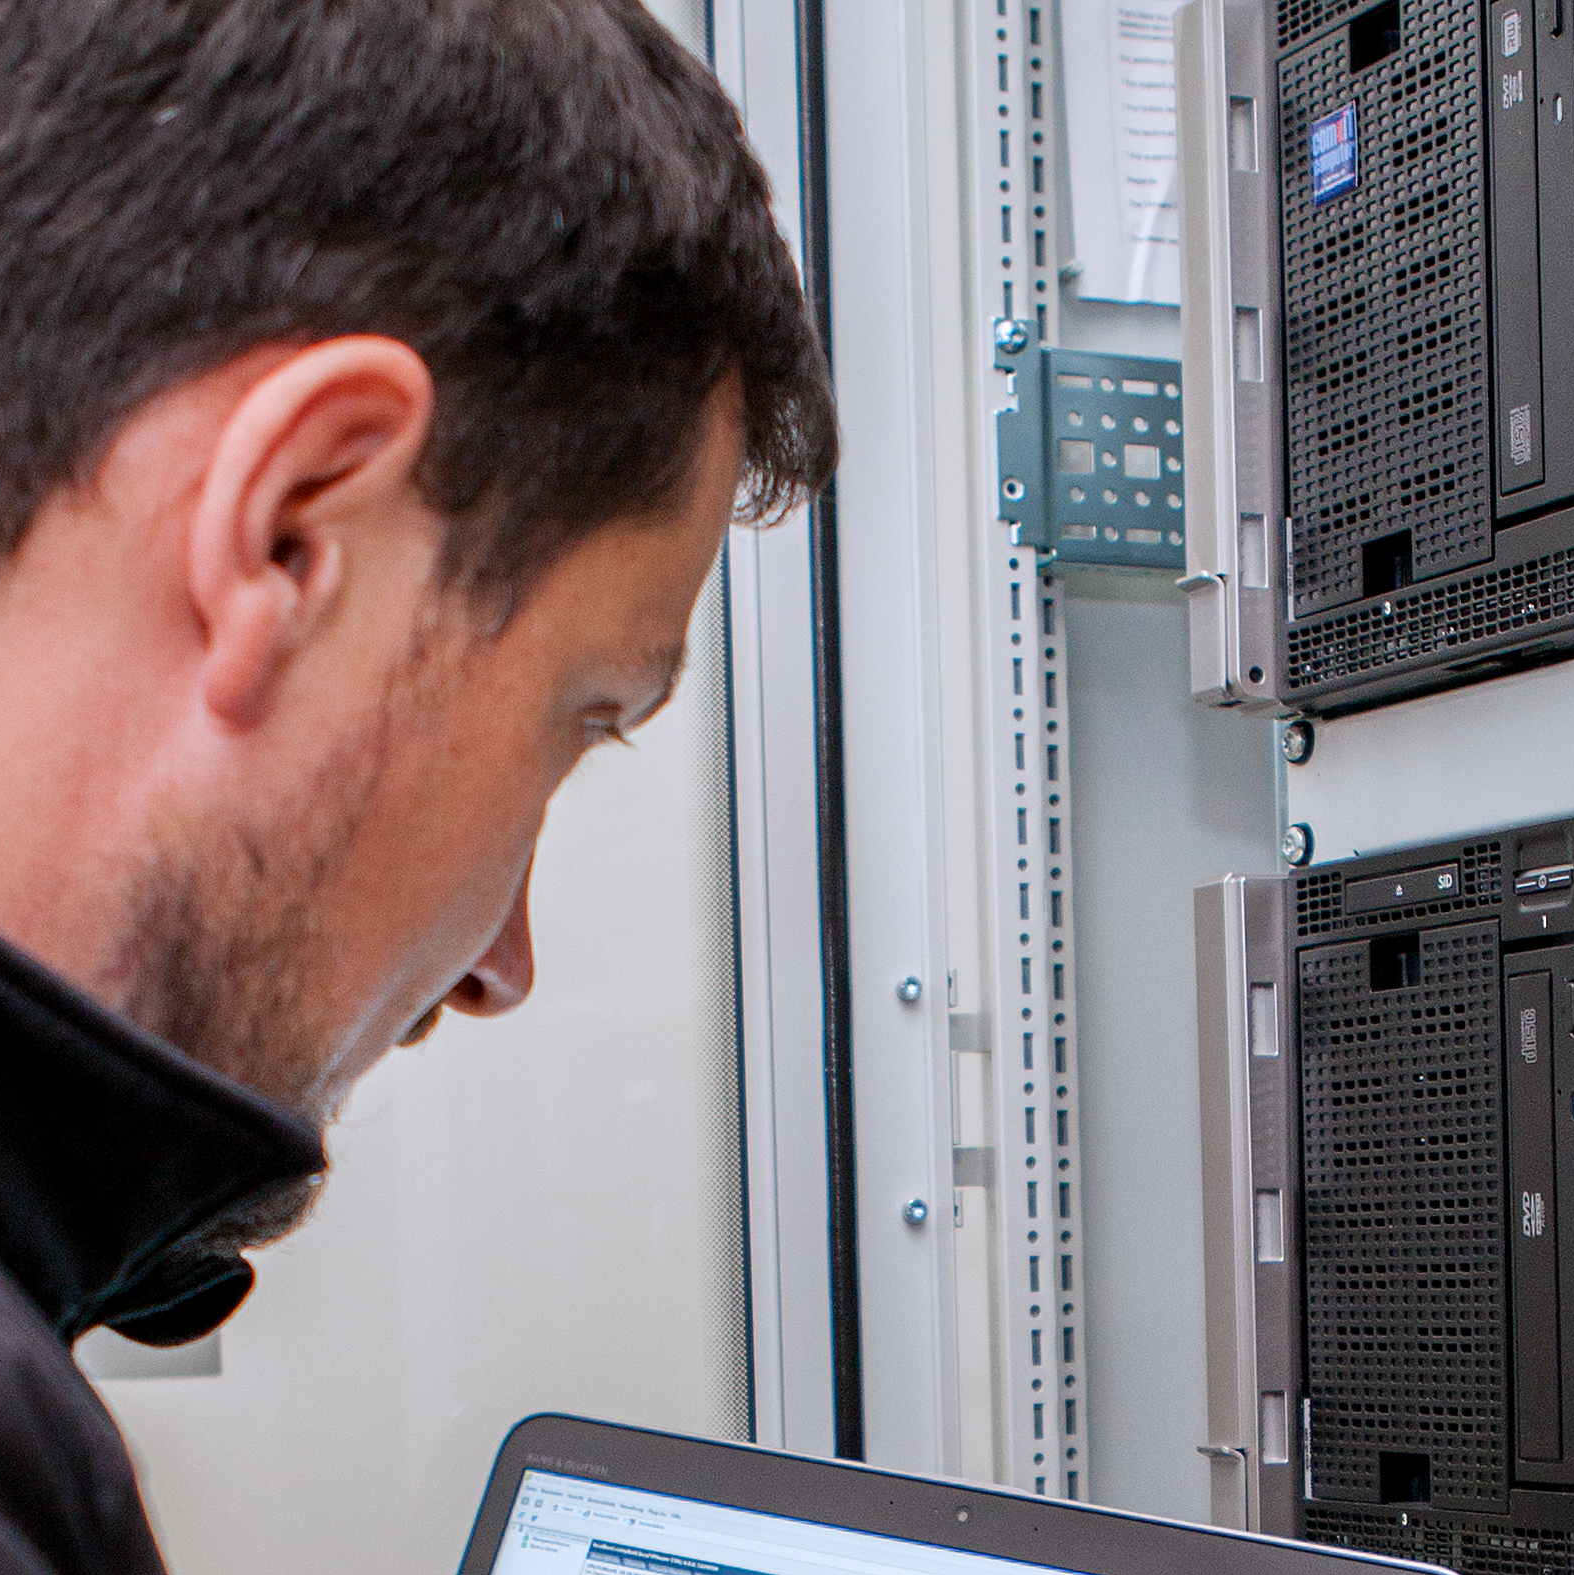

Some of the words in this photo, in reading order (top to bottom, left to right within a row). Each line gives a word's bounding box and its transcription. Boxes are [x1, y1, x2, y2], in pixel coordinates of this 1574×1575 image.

[1383, 601, 1392, 615] 3
[1437, 873, 1453, 890] SID
[1522, 1190, 1531, 1237] DVD
